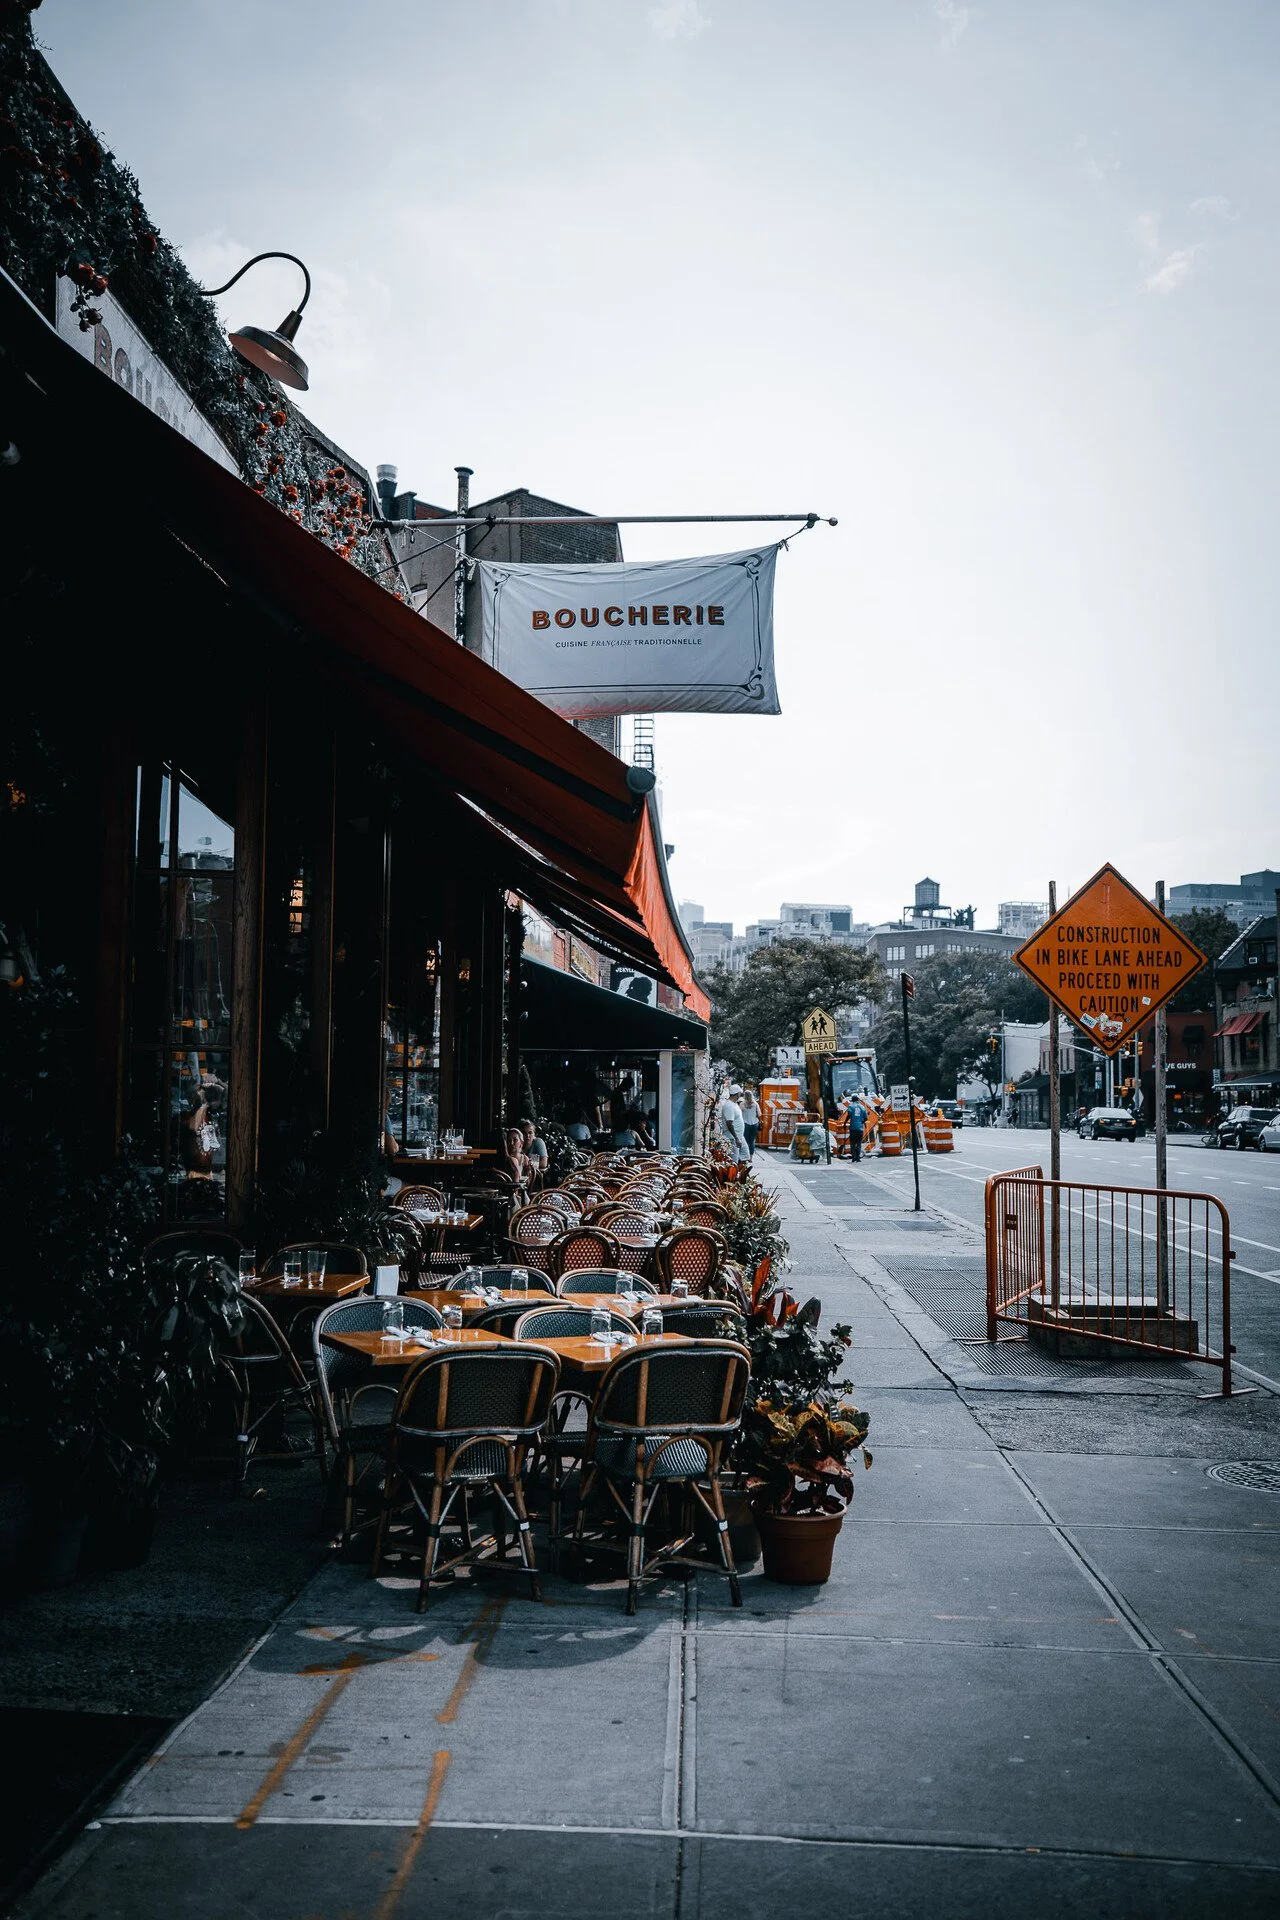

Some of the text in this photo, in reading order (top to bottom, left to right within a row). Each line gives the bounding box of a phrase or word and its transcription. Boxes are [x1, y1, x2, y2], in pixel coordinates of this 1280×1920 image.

[532, 605, 725, 630] BOUCHERIE
[555, 638, 702, 648] CUISINE FRANÇAISE TRADITIONNELLE
[1057, 926, 1161, 944] CONSTRUCTION
[1036, 949, 1183, 967] IN BIKE LANE AHEAD
[1059, 972, 1160, 990] PROCEED WITH
[1079, 995, 1139, 1013] CAUTION
[808, 1042, 834, 1051] AHEAD
